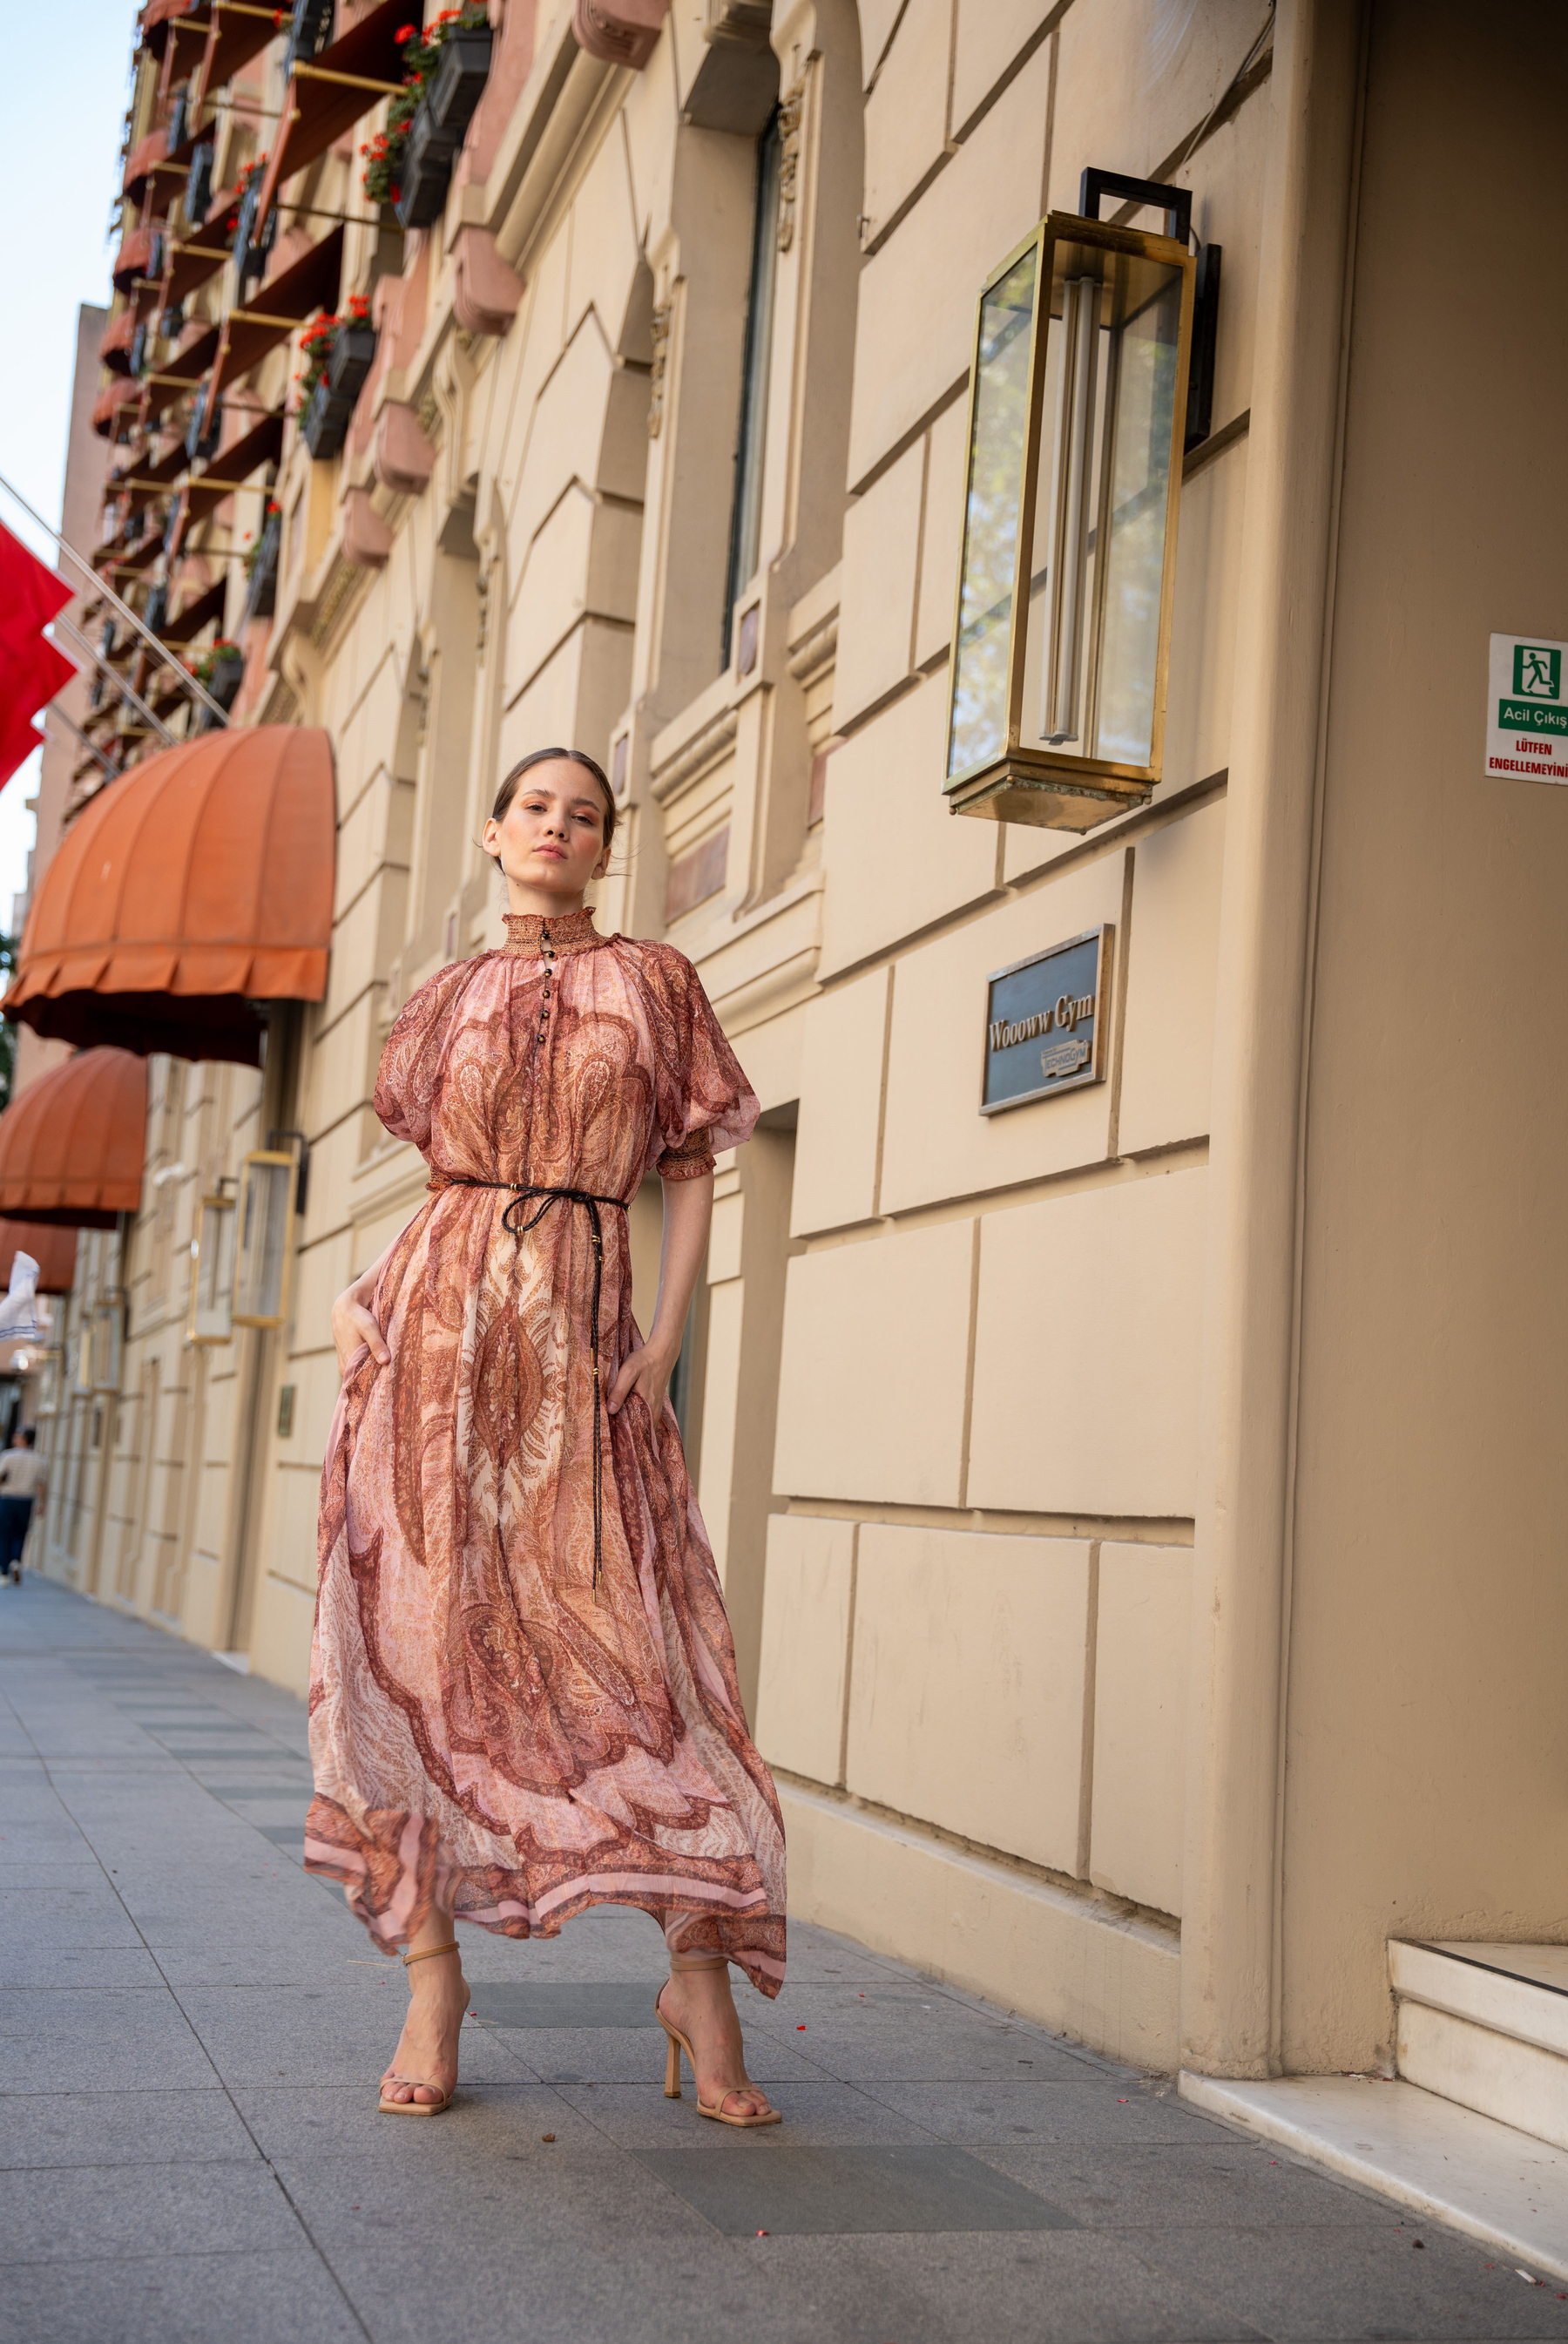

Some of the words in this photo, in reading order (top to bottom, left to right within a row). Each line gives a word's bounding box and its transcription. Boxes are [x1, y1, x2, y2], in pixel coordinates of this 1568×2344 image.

[1504, 707, 1530, 721] Acil
[1534, 710, 1567, 728] Çıkış
[1516, 738, 1552, 755] LÜTFEN
[989, 1010, 1052, 1052] Woooww
[1054, 994, 1094, 1032] Gym
